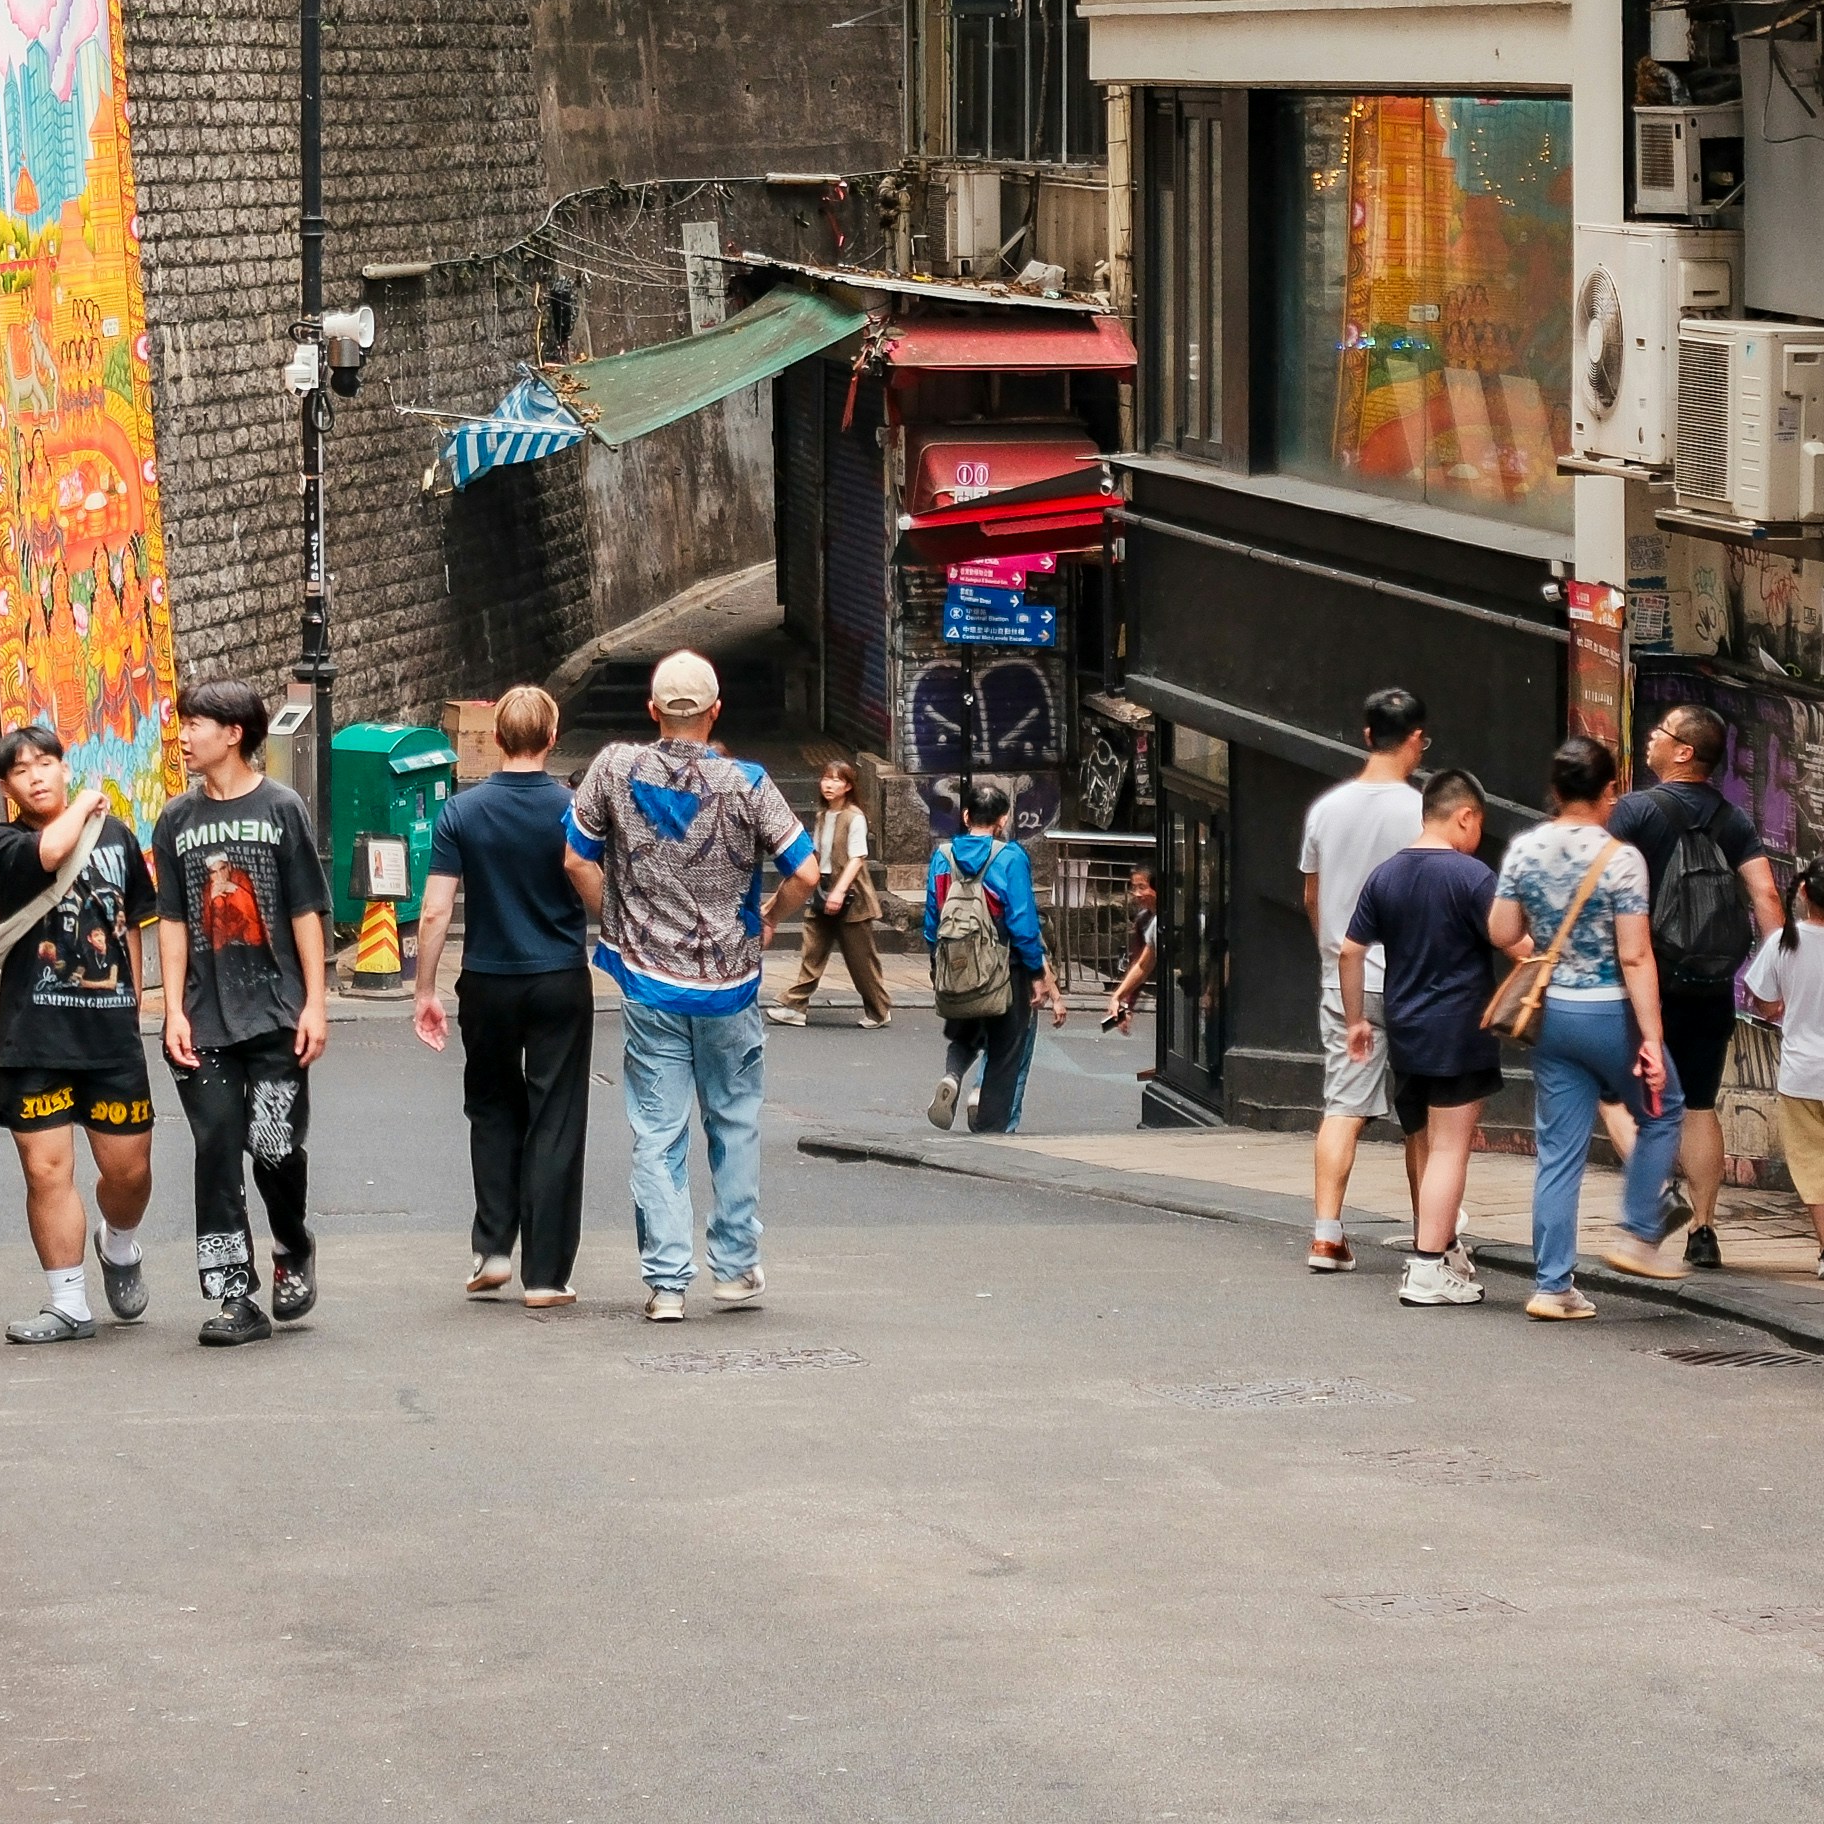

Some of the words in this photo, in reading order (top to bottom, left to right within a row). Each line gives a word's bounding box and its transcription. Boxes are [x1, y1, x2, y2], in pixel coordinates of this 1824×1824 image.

[33, 993, 86, 1009] MEMPHIS
[87, 994, 138, 1010] GRIZZLIES
[19, 1085, 75, 1121] JUST
[90, 1100, 128, 1125] DO
